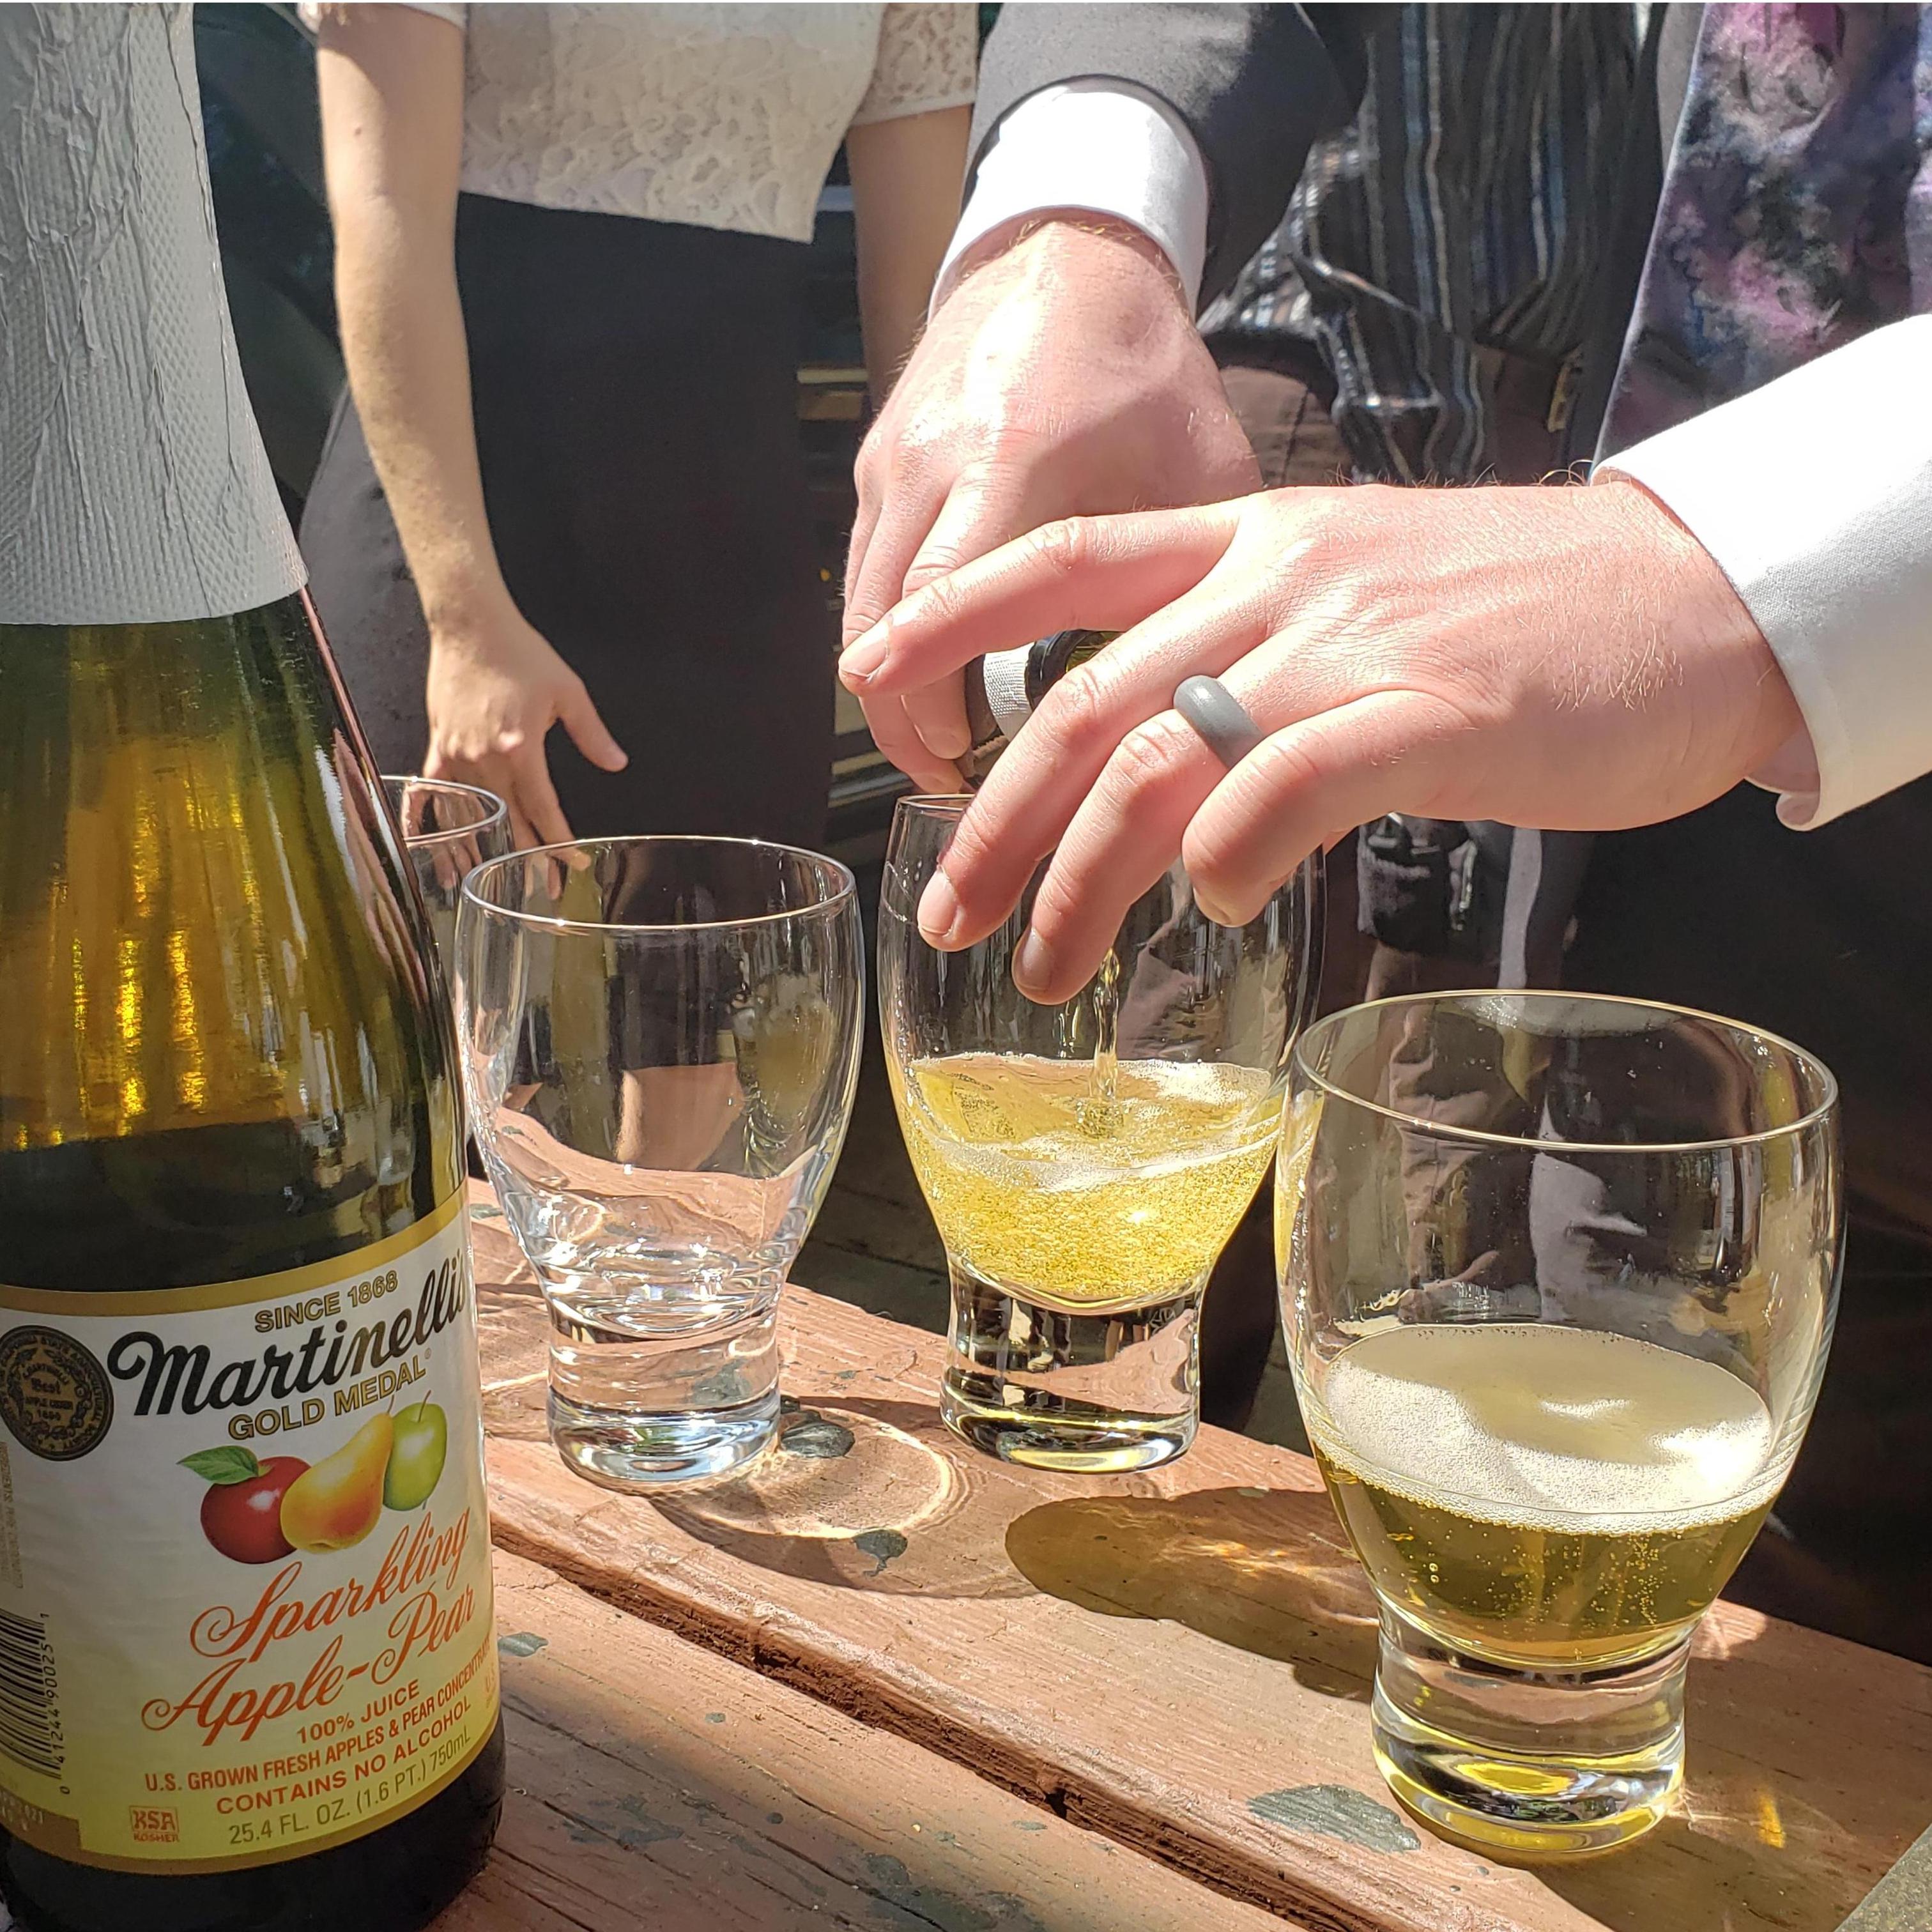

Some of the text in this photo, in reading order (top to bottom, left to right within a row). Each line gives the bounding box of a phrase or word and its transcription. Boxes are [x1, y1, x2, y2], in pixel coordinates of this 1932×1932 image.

[107, 1248, 466, 1416] Martinelli's
[254, 1269, 399, 1333] SINCE 1868
[228, 1354, 427, 1441] GOLD MEDAL
[190, 1506, 471, 1664] Sparkling
[141, 1581, 475, 1747] Apple-Pear
[296, 1678, 420, 1744] 100% JUICE
[145, 1773, 183, 1791] U.S.
[187, 1764, 259, 1791] GROWN
[263, 1749, 321, 1781] FRESH
[325, 1726, 385, 1765] APPLES
[388, 1719, 400, 1738] &
[402, 1696, 436, 1731] PEAR
[216, 1695, 472, 1814] CONTAINS NO ALCOHOL
[229, 1726, 471, 1845] 25.4 FL. OZ. (1.6 PT.) 750mL
[133, 1809, 176, 1830] KSA
[133, 1832, 180, 1843] KOSHER
